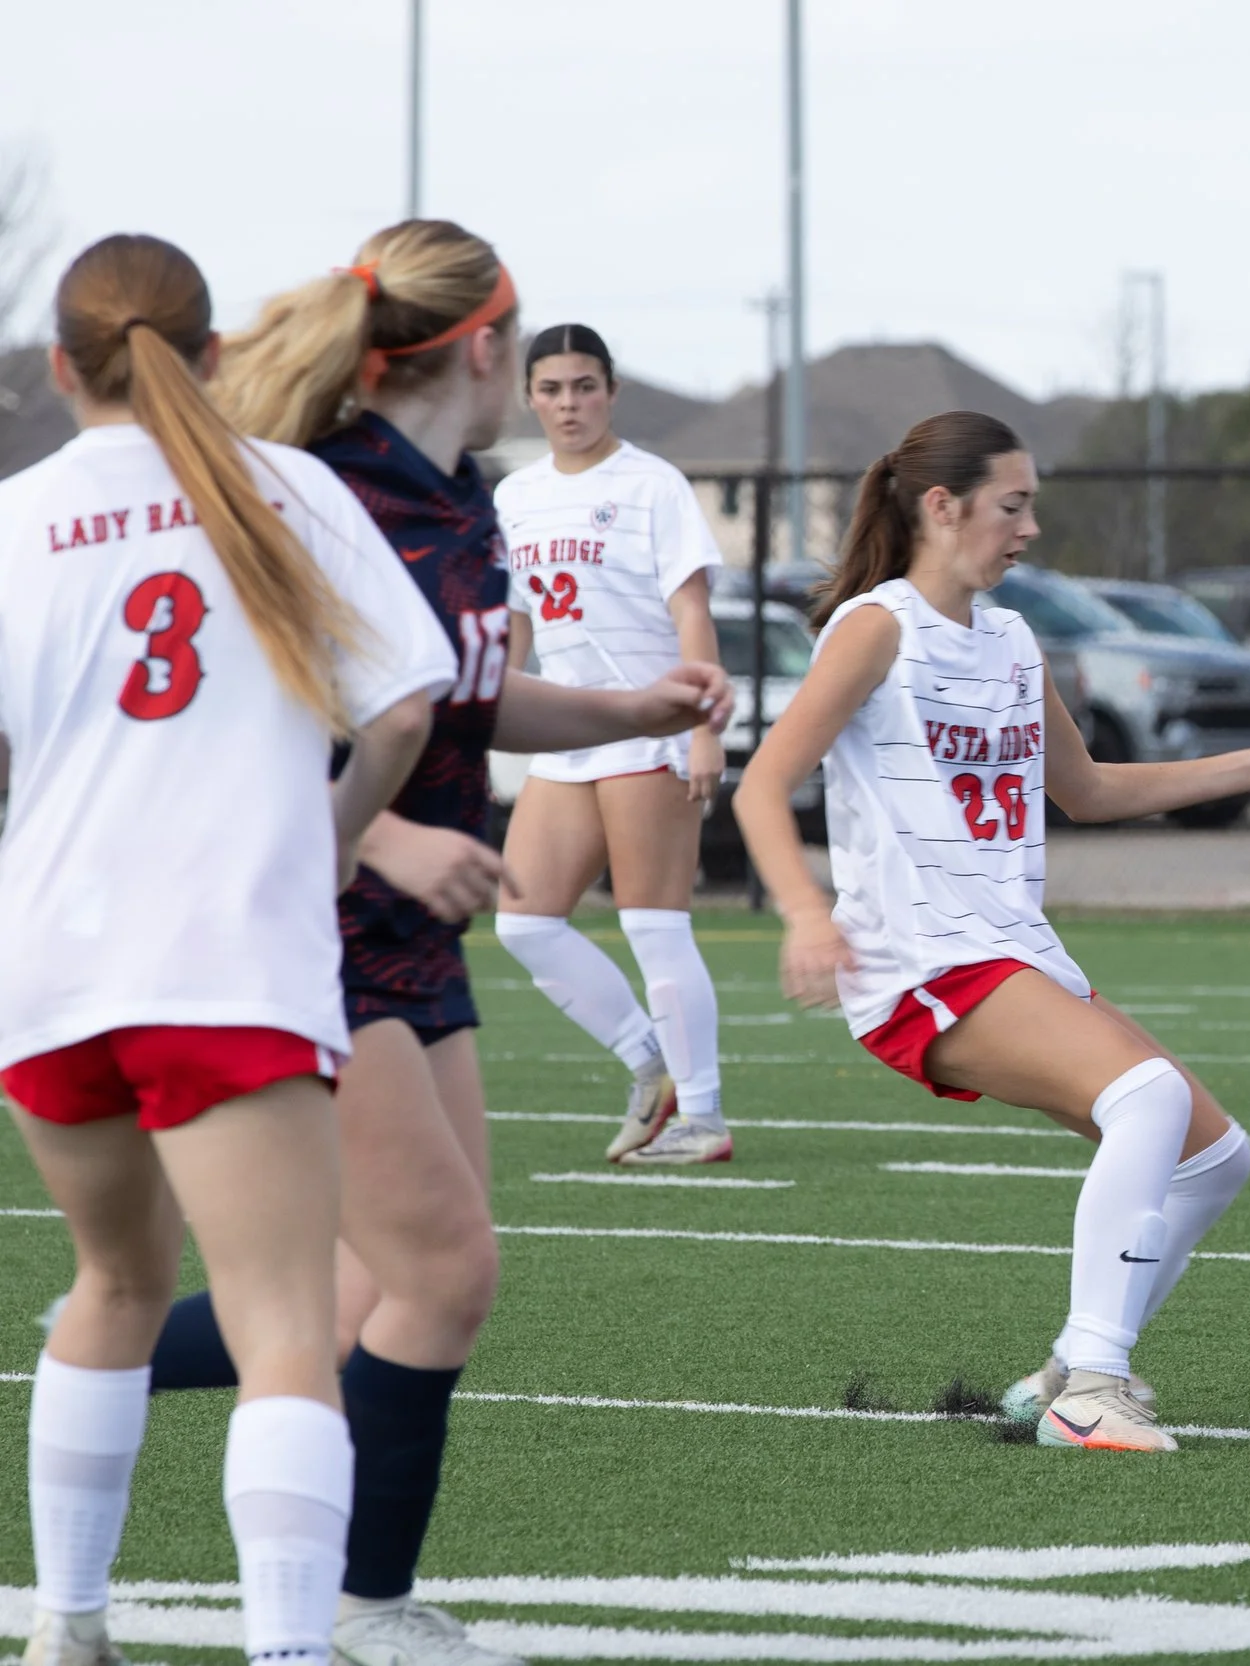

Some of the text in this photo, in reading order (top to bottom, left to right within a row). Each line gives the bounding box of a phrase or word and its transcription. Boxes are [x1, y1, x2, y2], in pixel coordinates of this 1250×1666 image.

[49, 508, 130, 553] LADY
[549, 538, 605, 567] RIDGE
[118, 571, 210, 720] 3
